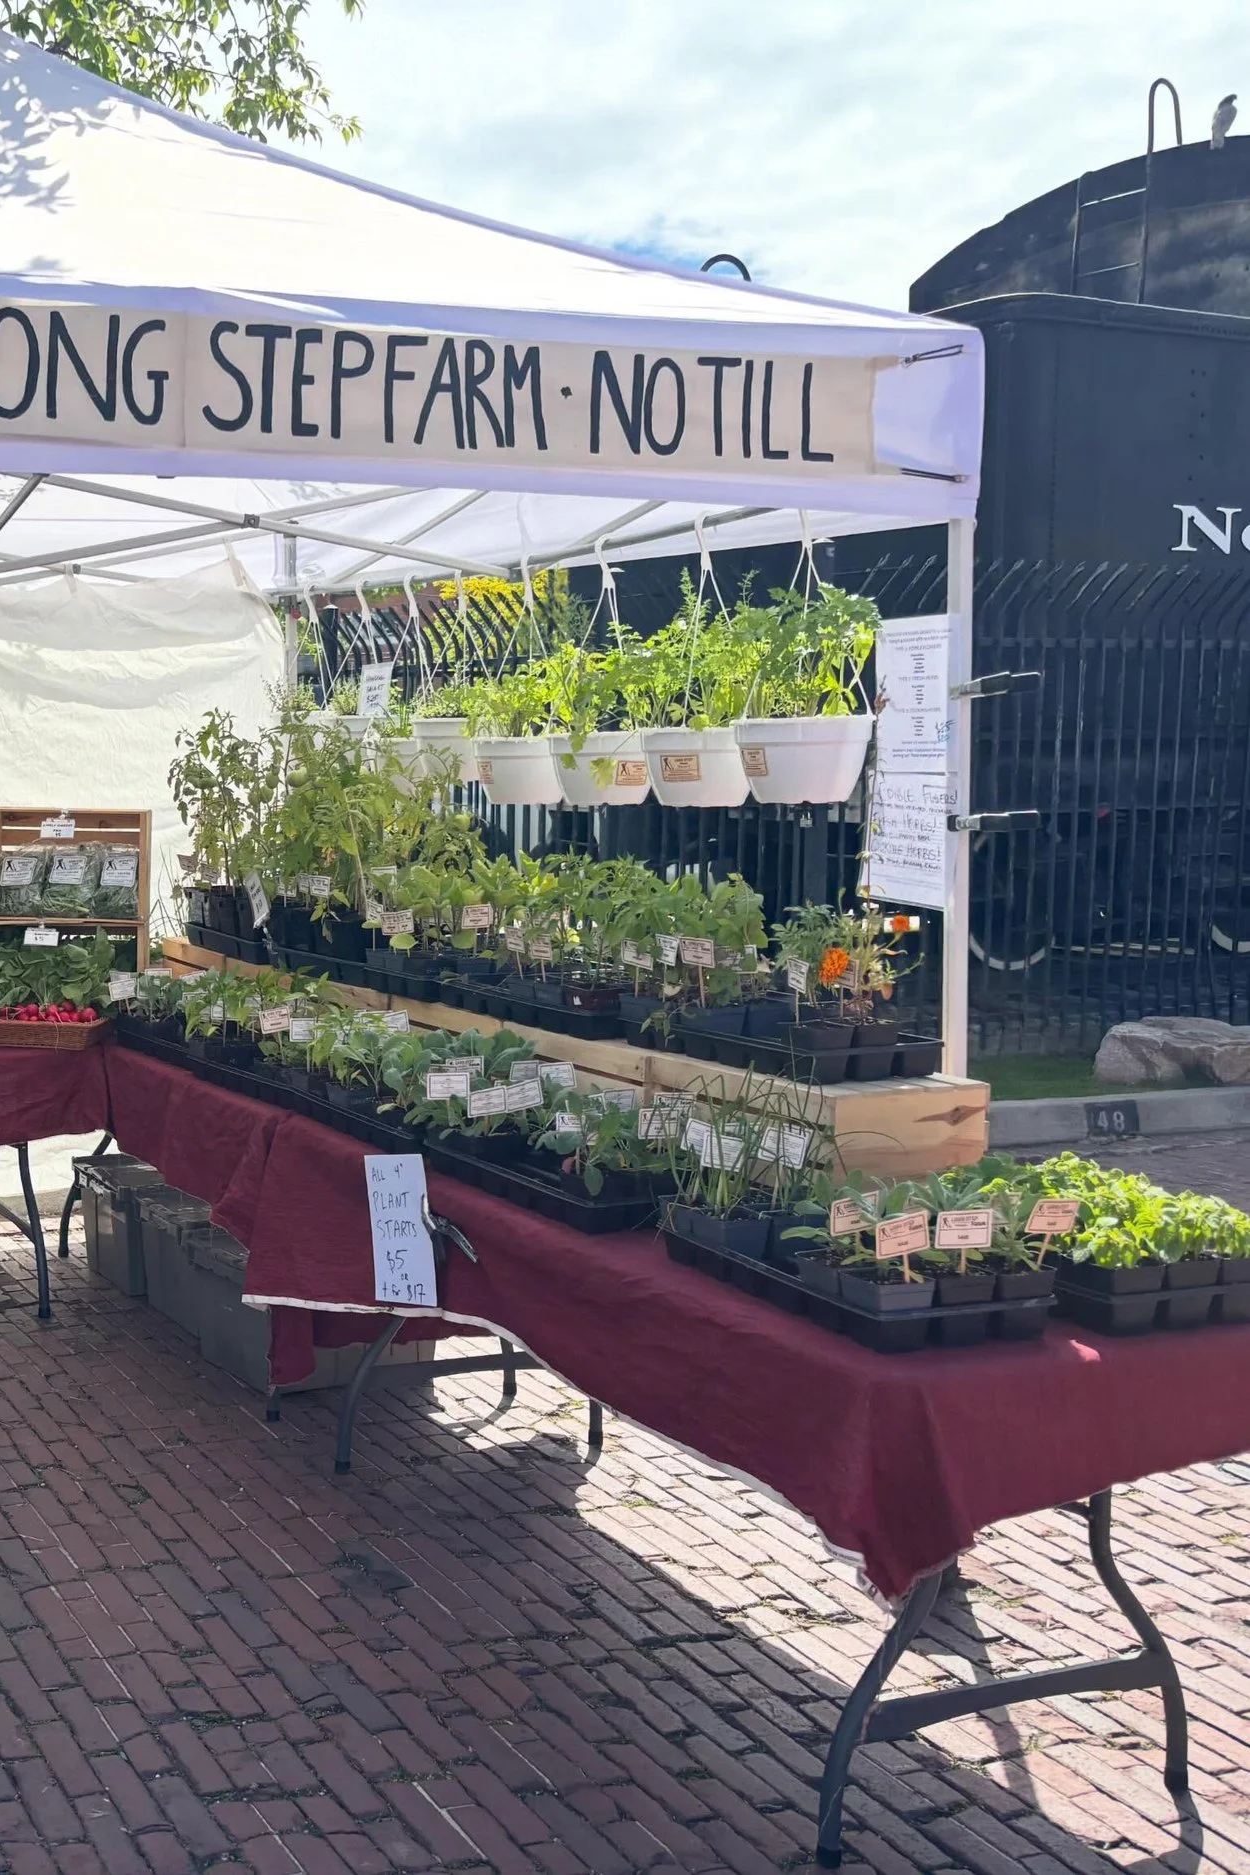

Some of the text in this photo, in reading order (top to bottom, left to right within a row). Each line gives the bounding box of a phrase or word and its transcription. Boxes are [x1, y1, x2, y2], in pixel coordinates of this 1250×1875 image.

[371, 1167, 386, 1182] ALL
[372, 1190, 410, 1213] PLANT
[376, 1219, 418, 1242] STARTS
[386, 1249, 409, 1274] $5
[406, 1283, 427, 1304] $17
